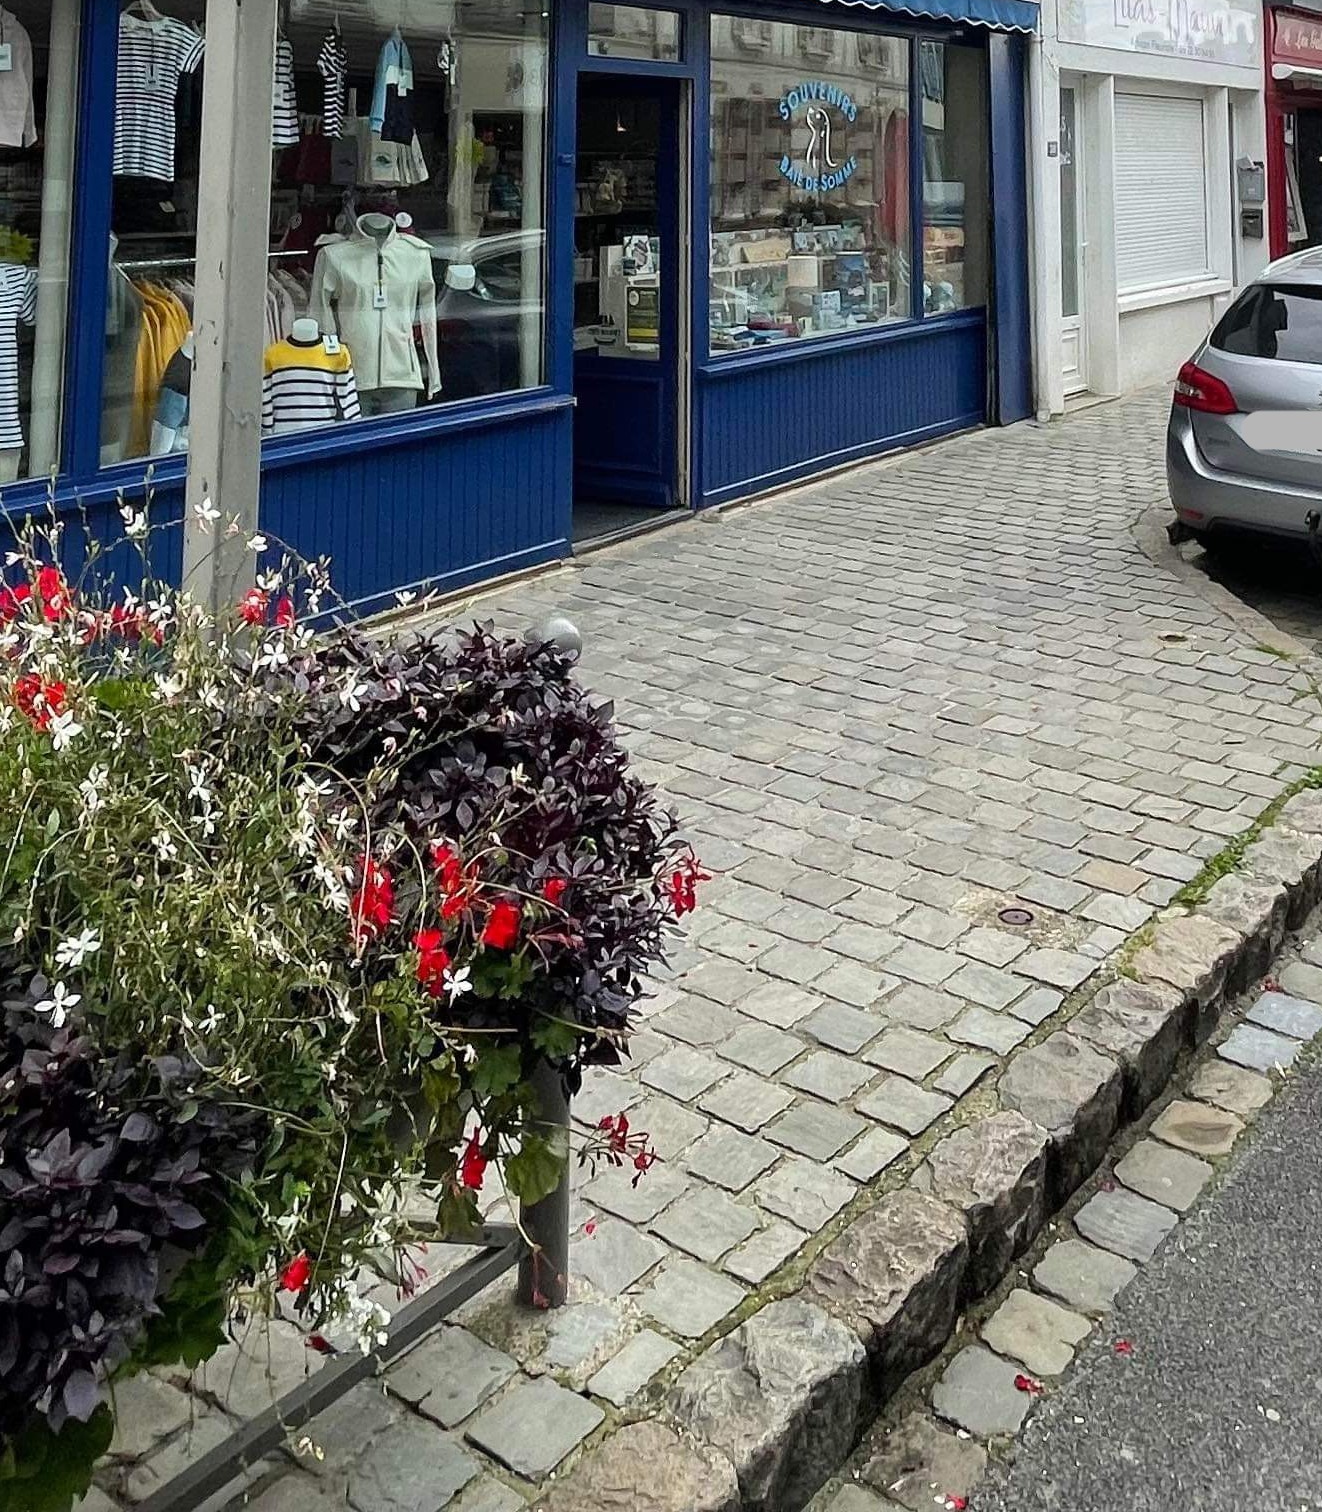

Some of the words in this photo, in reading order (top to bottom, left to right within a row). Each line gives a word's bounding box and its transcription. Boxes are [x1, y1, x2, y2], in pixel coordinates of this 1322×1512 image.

[779, 82, 857, 121] SOUVENIRS
[780, 155, 804, 186] BAIE
[805, 176, 820, 192] DE
[821, 155, 857, 191] SOMME
